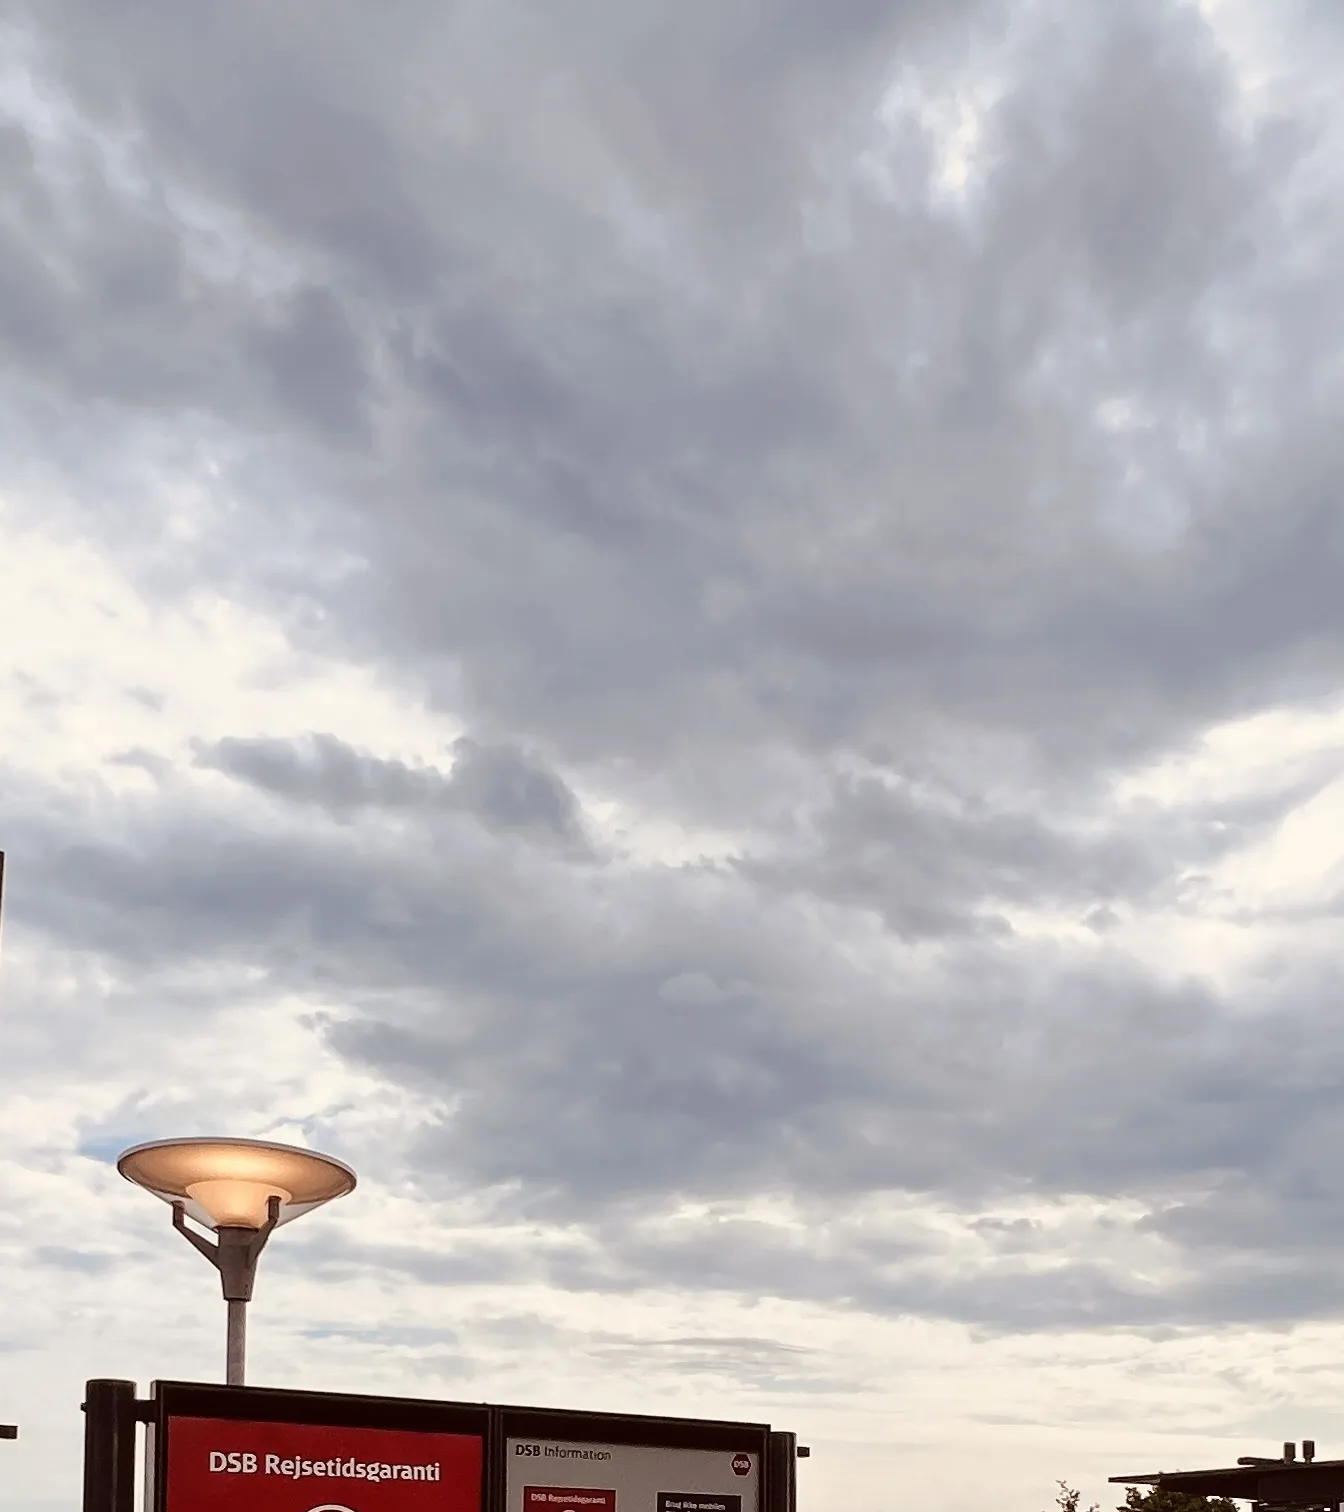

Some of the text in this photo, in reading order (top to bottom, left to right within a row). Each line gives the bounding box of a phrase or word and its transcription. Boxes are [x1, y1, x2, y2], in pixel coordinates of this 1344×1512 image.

[516, 1444, 612, 1460] DSB Information
[209, 1451, 440, 1483] DSB Rejsetidsgaranti
